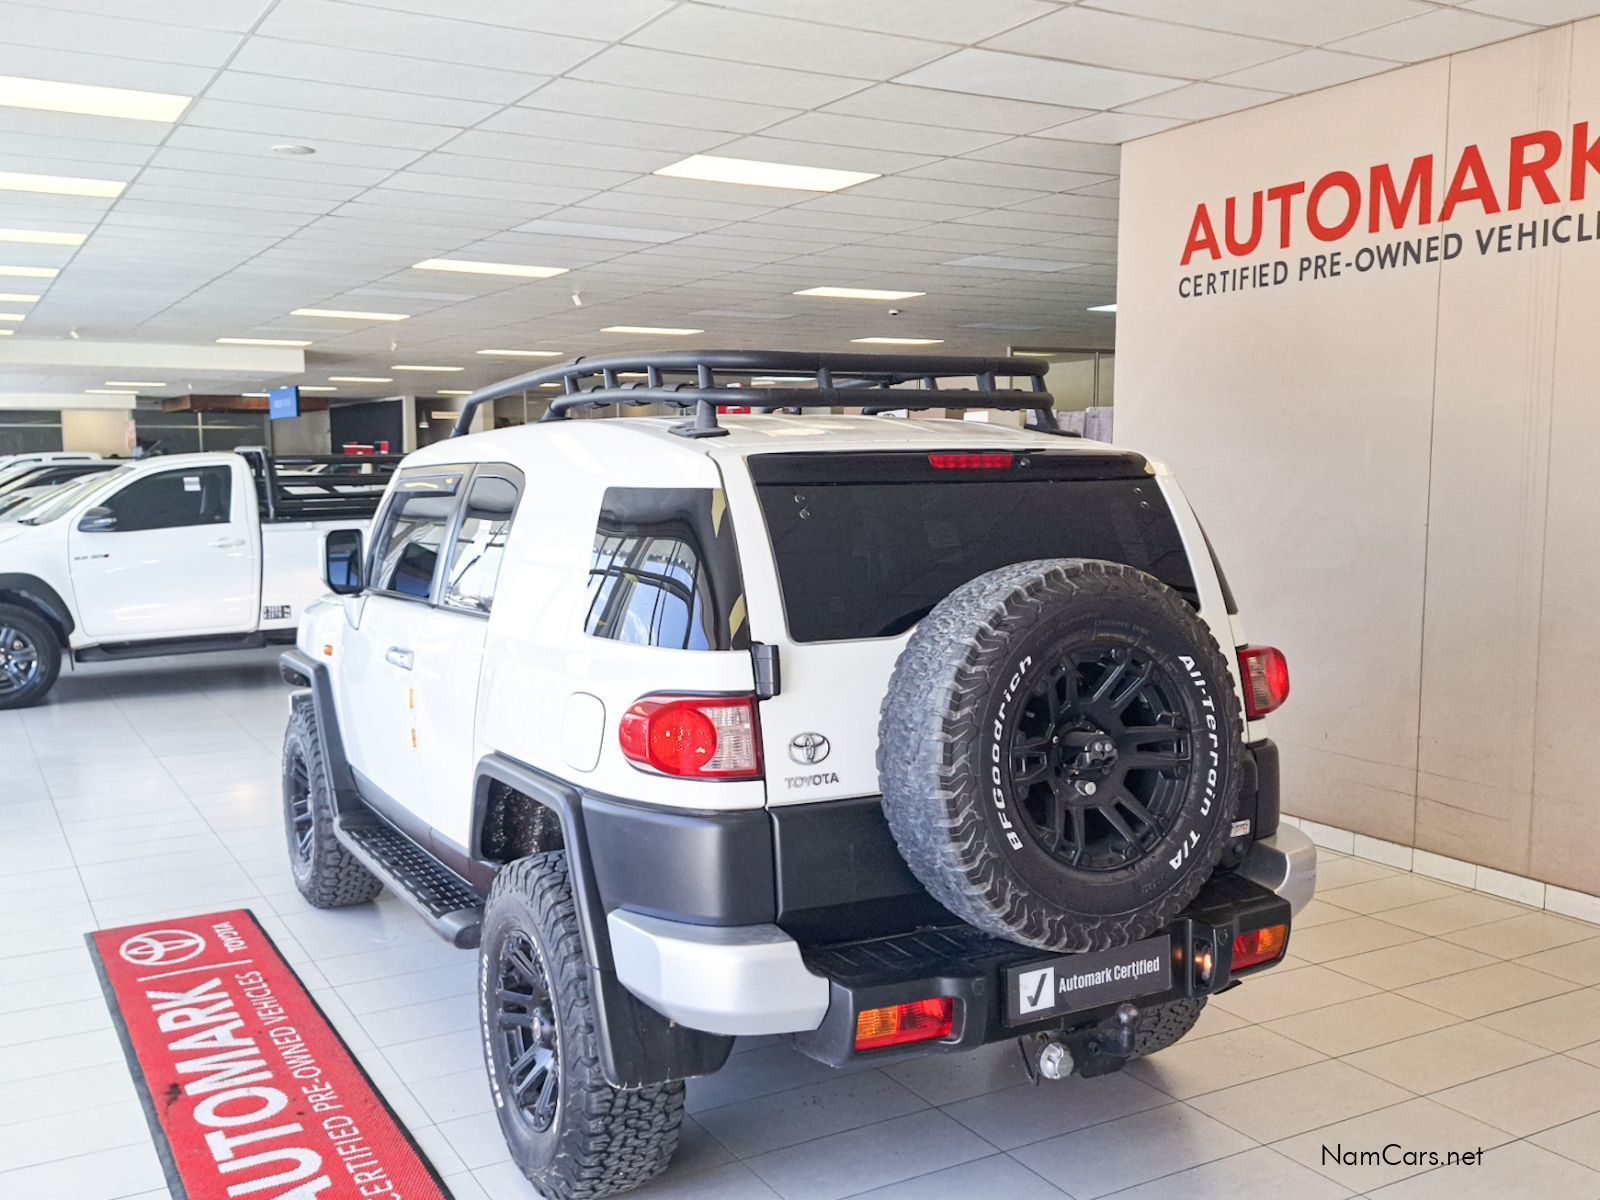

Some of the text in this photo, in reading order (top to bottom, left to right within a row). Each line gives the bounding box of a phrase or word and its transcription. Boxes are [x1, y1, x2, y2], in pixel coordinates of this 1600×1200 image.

[1178, 210, 1600, 298] CERTIFIED PRE-OWNED VEHICL
[1179, 121, 1600, 266] AUTOMARK
[784, 772, 839, 789] TOYOTA
[992, 655, 1032, 850] BFGoodrich
[1178, 656, 1218, 816] All-Terrain
[1058, 956, 1160, 993] Automark Certified
[234, 971, 400, 1200] ERTIFIED PRE-OWNED VEHICLES
